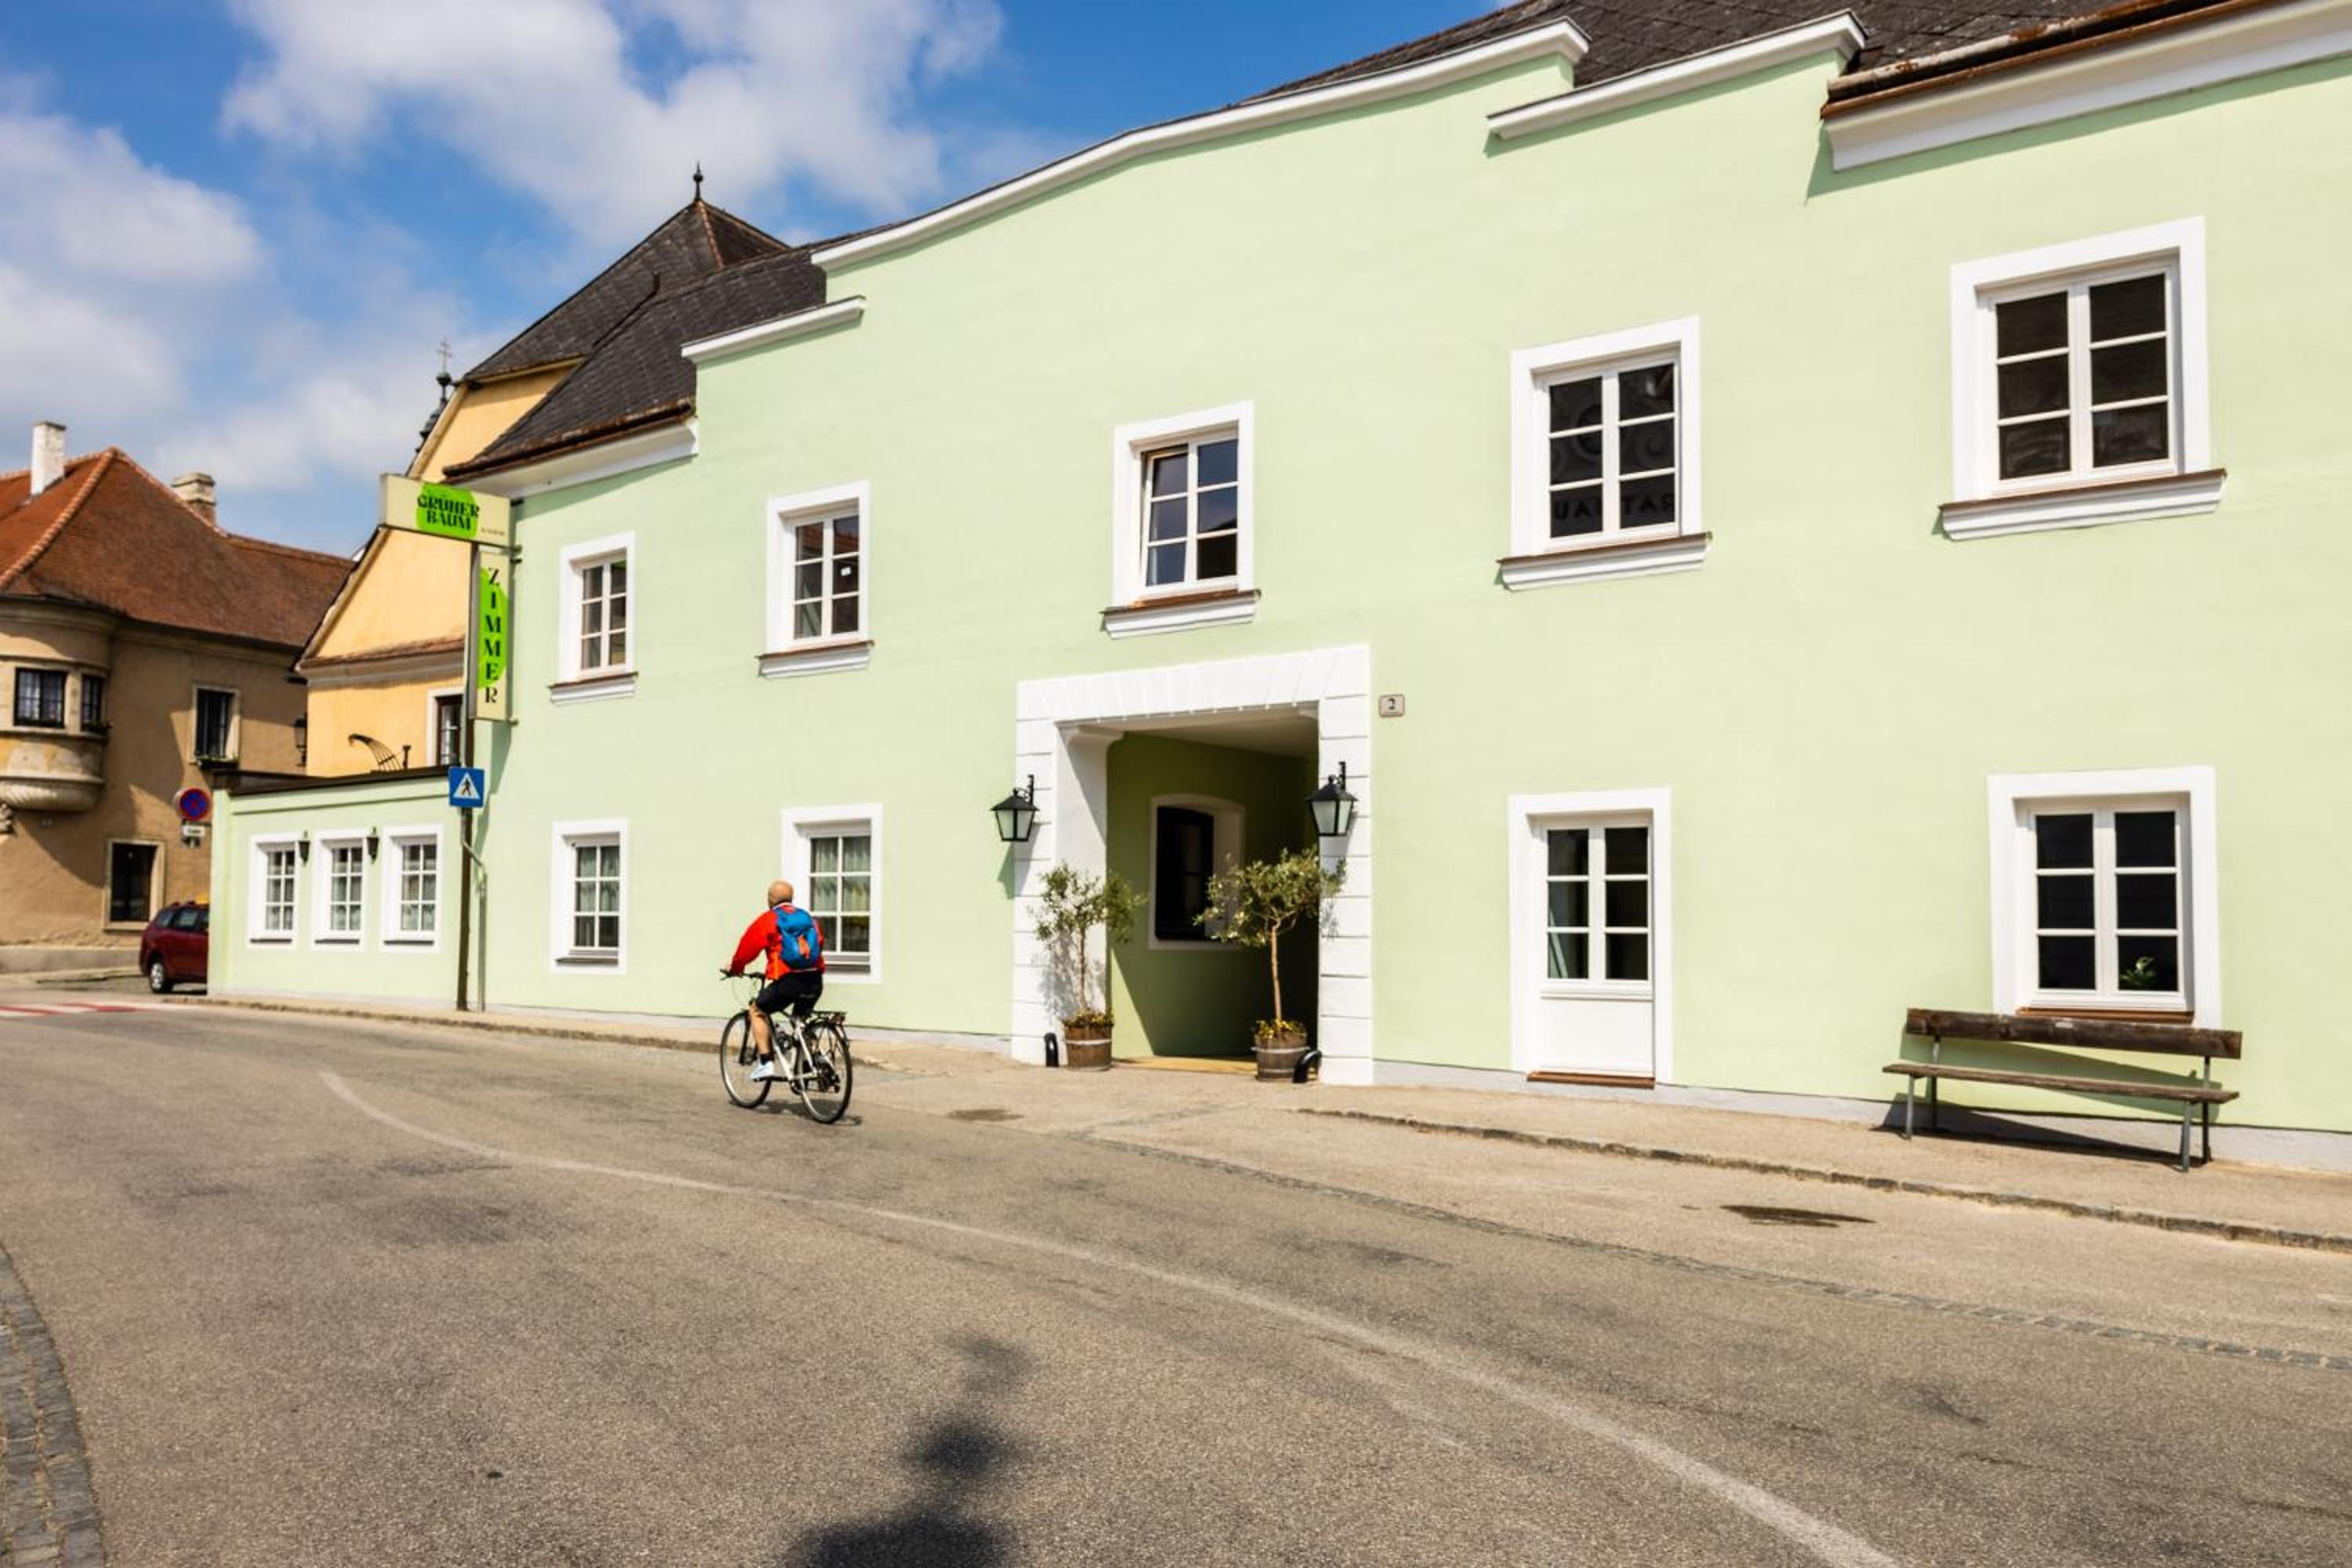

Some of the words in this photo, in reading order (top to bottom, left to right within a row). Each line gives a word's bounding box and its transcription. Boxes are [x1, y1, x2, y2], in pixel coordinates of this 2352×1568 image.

[426, 510, 470, 530] BAUM
[485, 566, 502, 703] ZIMMER
[1387, 697, 1396, 710] 2
